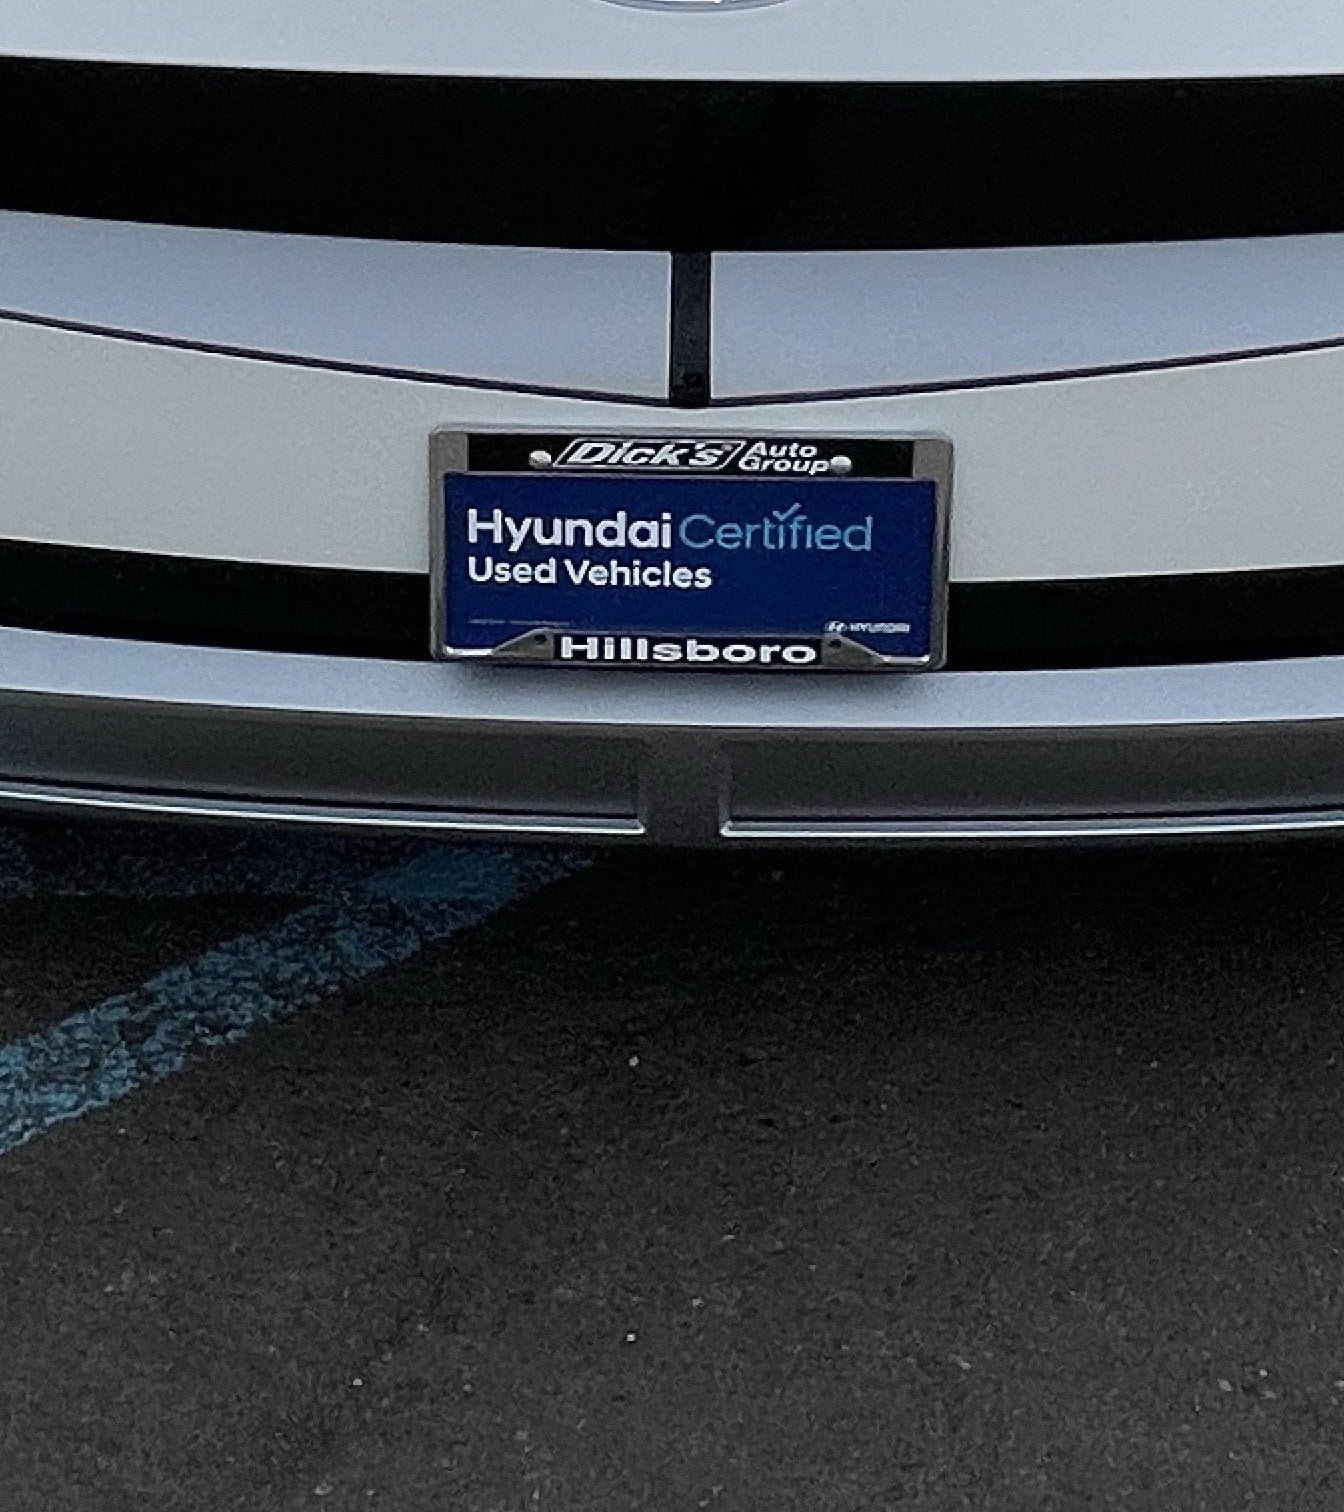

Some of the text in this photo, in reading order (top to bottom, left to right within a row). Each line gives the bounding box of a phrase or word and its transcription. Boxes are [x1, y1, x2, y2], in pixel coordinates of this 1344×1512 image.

[738, 455, 831, 476] Group
[747, 441, 818, 461] Auto
[466, 502, 874, 553] Hyundai Certified
[467, 556, 713, 589] Used Vehicles
[558, 635, 817, 664] Hillsboro
